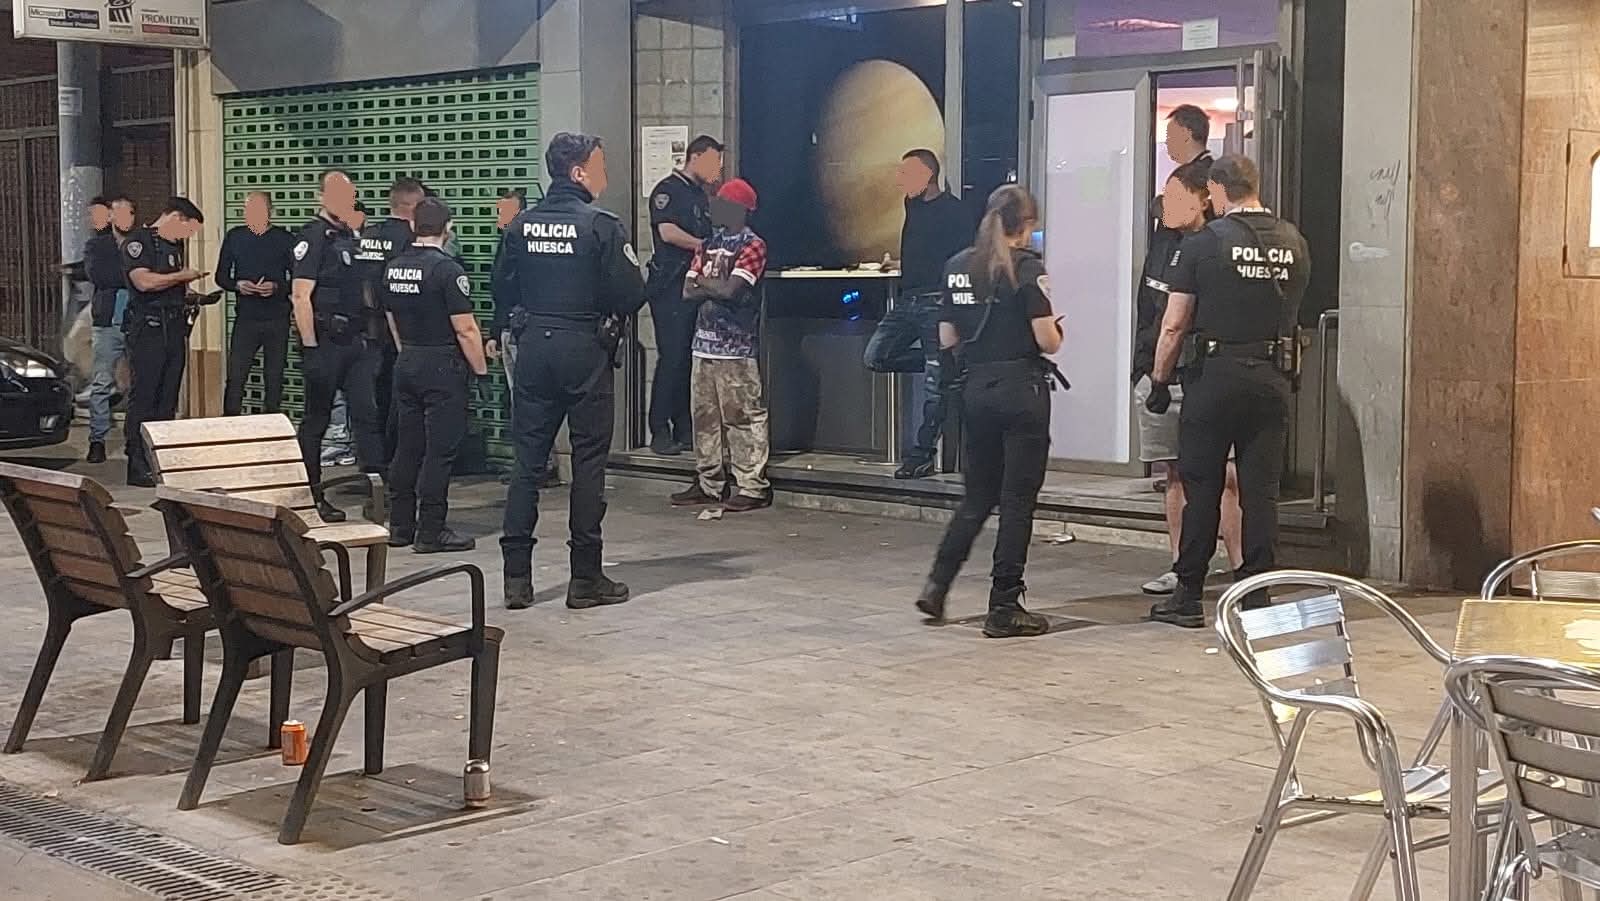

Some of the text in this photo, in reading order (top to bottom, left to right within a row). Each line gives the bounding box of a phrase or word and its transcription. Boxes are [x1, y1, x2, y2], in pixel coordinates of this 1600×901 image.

[523, 223, 577, 239] POLICIA
[527, 241, 574, 254] HUESCA
[1231, 246, 1294, 265] POLCIA
[387, 268, 423, 281] POLICIA
[947, 273, 972, 289] POL
[389, 282, 420, 294] HUESCA
[952, 292, 976, 305] HUE
